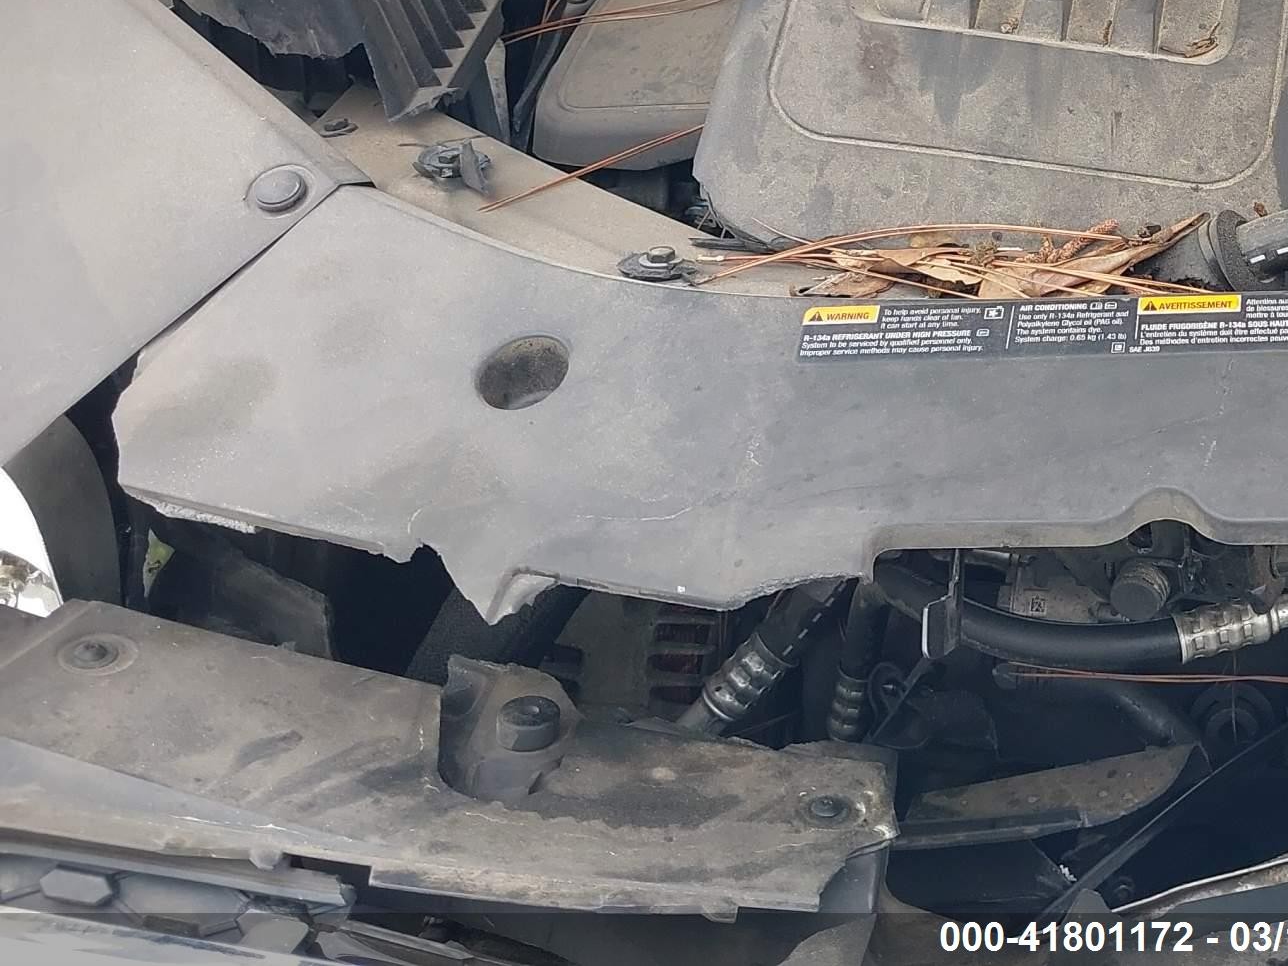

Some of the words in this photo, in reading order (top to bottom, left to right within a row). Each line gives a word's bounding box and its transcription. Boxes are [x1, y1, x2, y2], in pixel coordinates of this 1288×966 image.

[1034, 303, 1088, 311] CONDITIONING
[1159, 300, 1233, 310] AVERTISSEMENT
[826, 312, 869, 321] WARNING
[893, 309, 908, 317] help
[929, 308, 960, 316] personal
[1033, 313, 1047, 321] only
[1076, 311, 1114, 319] Refrigerant
[1017, 320, 1060, 328] Polyalkylene
[1061, 319, 1082, 327] Glycol
[1141, 323, 1167, 331] FLUIDE
[1168, 321, 1218, 330] FRIGORIGÈNE
[832, 332, 883, 341] REFRIGERANT
[885, 331, 911, 339] UNDER
[912, 330, 930, 338] HIGH
[932, 329, 971, 337] PRESSURE
[1031, 328, 1056, 336] system
[1140, 330, 1177, 338] L'entretien
[1189, 329, 1218, 337] système
[1250, 327, 1278, 335] effectué
[801, 342, 828, 350] System
[890, 339, 919, 347] qualified
[920, 338, 955, 346] personnel
[957, 337, 973, 345] only.
[1015, 336, 1040, 344] System
[1042, 334, 1068, 343] charge:
[1087, 334, 1096, 342] kg
[1098, 333, 1116, 341] (1.43
[1155, 337, 1189, 345] méthodes
[1229, 335, 1268, 343] incorrectes
[800, 349, 831, 357] Improper
[930, 345, 961, 353] personal
